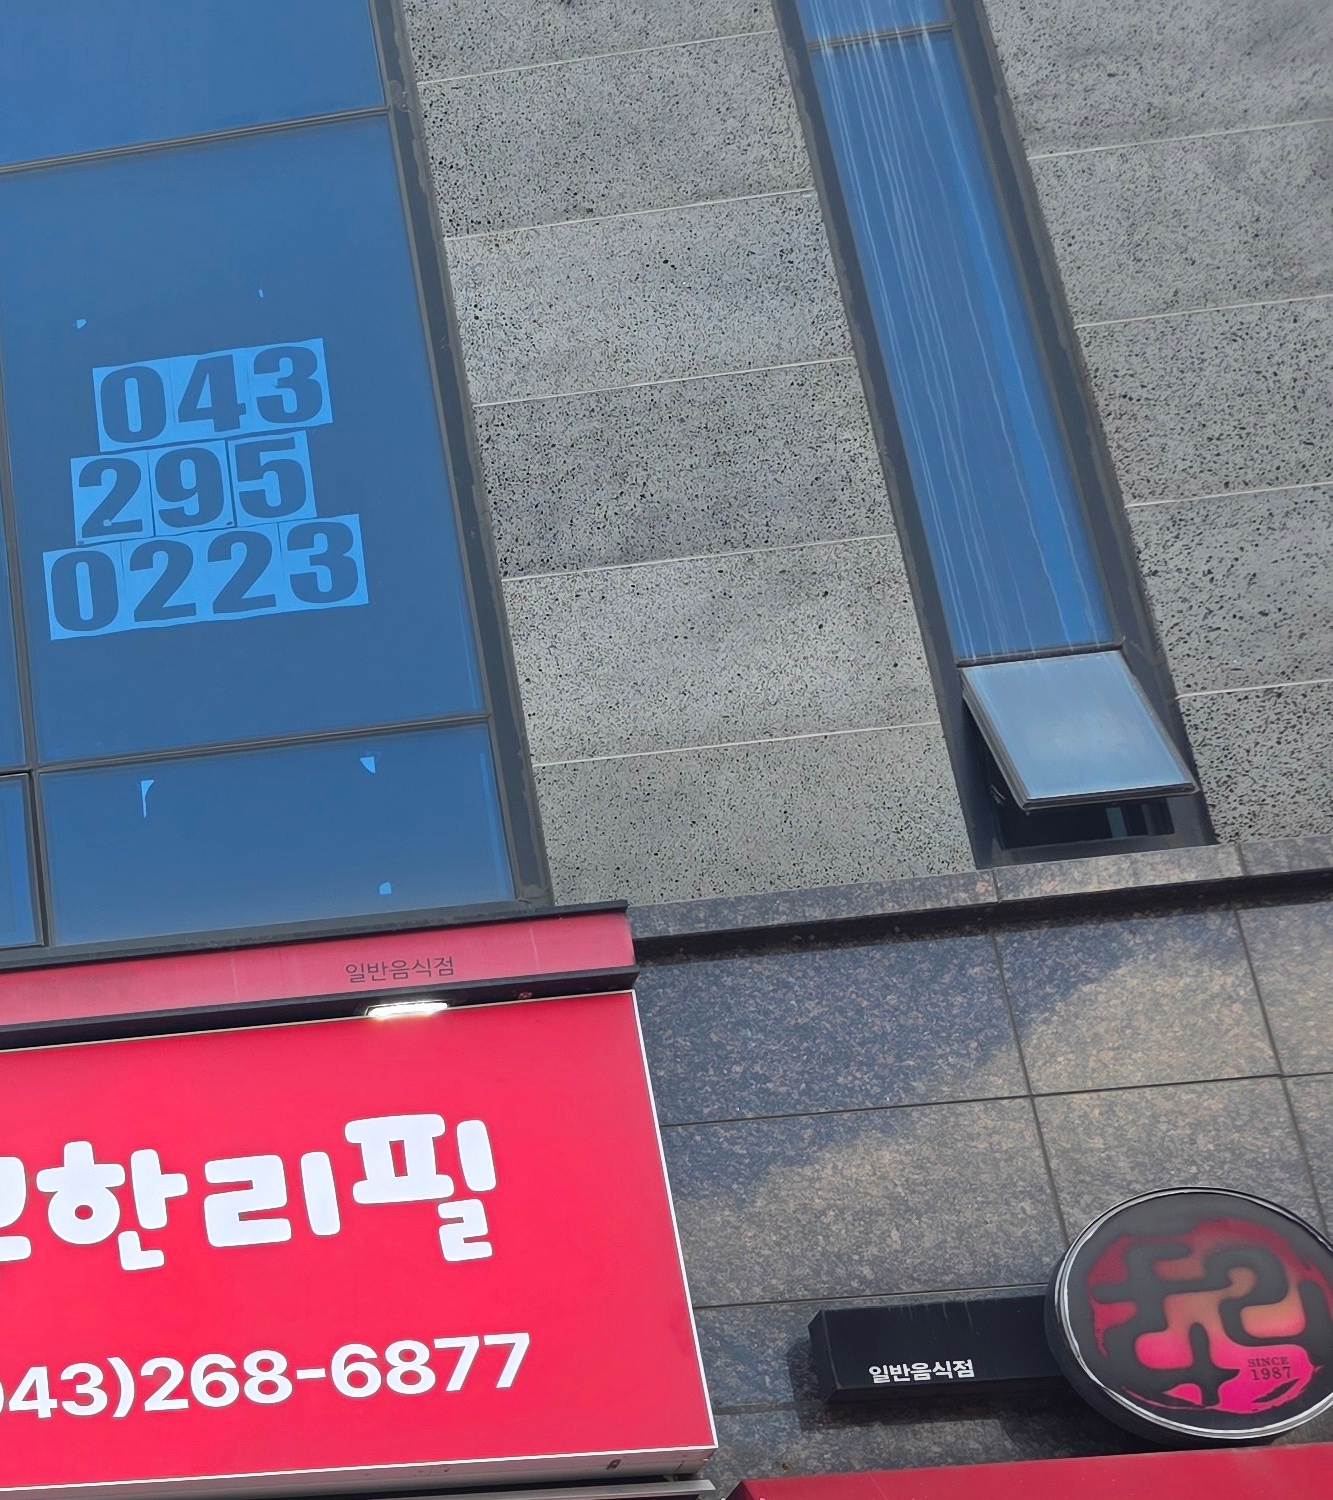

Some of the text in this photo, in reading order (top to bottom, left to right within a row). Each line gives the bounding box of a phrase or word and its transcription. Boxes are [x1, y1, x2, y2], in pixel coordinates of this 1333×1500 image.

[100, 346, 323, 443] 043
[78, 437, 307, 538] 295
[50, 521, 359, 632] 0223
[345, 956, 454, 984] 일반음식점
[868, 1359, 974, 1384] 일반음식점
[1247, 1356, 1289, 1368] SINCE
[1249, 1366, 1292, 1382] 1987
